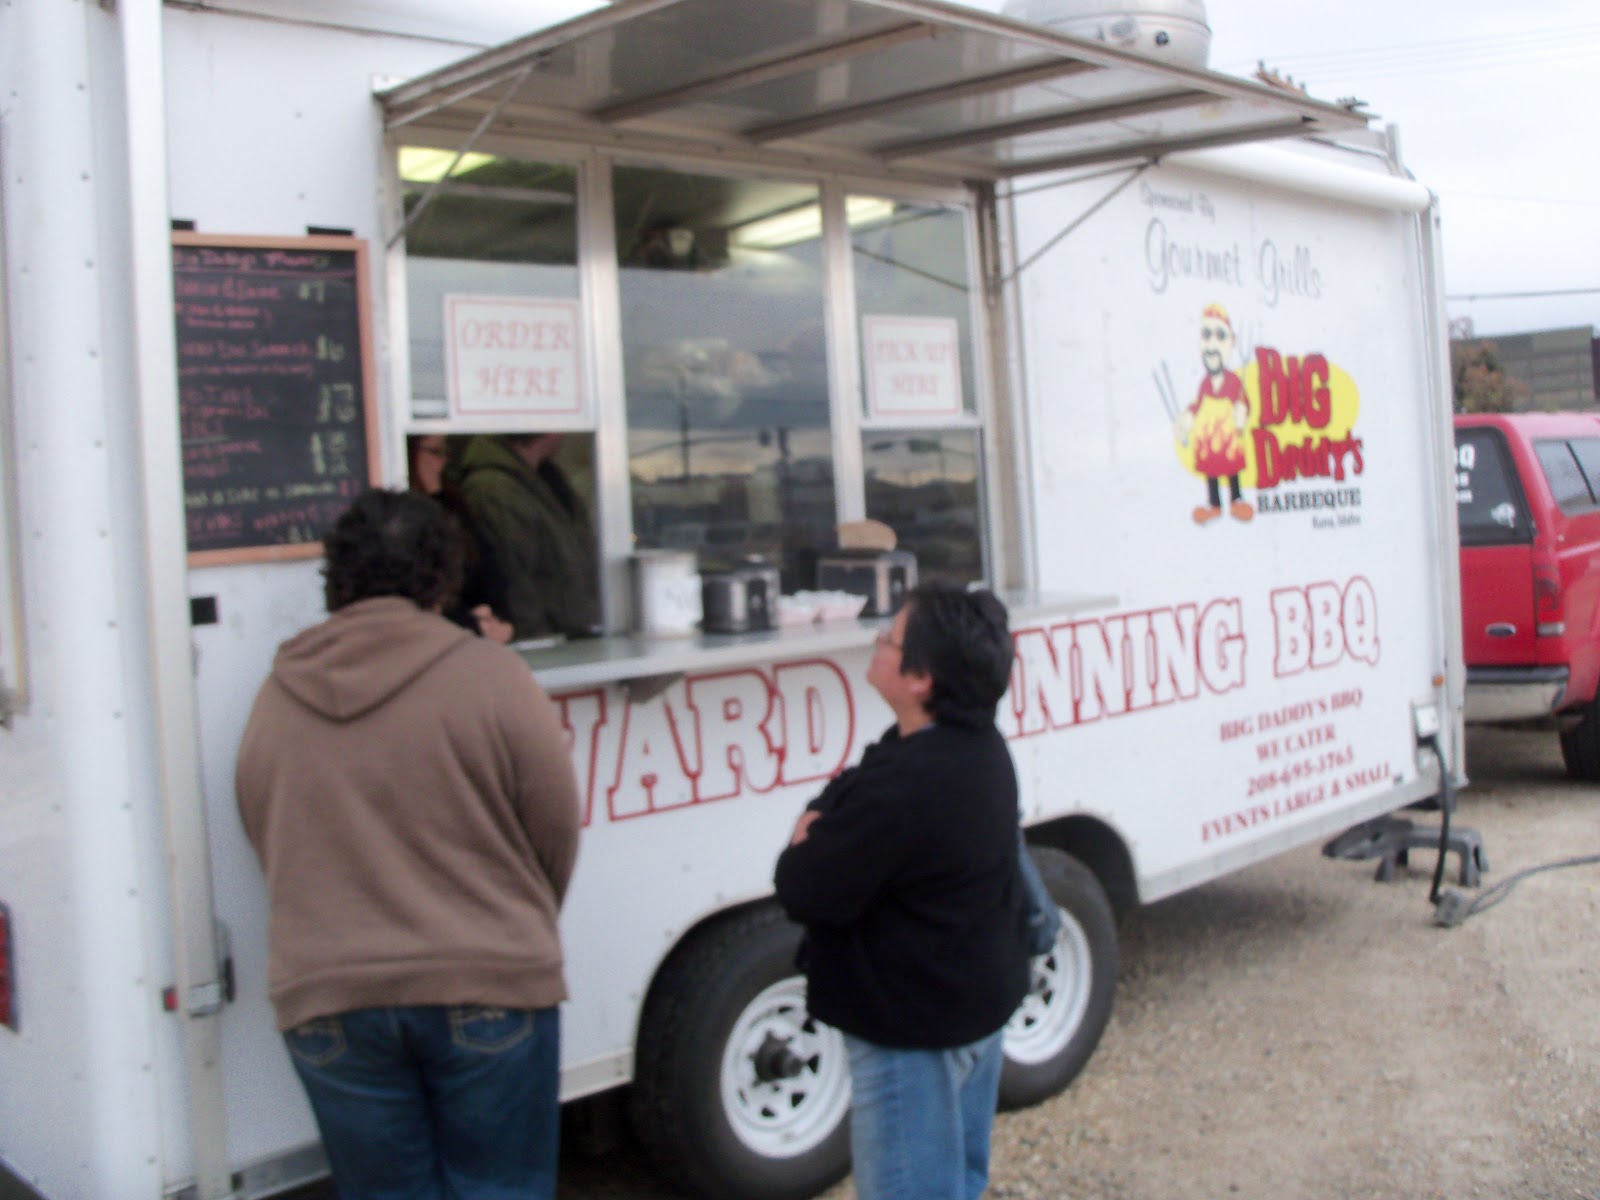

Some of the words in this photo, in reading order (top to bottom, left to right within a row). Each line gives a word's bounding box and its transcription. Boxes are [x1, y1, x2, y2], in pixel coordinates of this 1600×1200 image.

[461, 319, 571, 349] ORDER
[474, 364, 563, 396] HERE
[1255, 346, 1331, 429] BIG
[1257, 488, 1361, 513] BARBEQUE
[551, 657, 855, 827] ARD
[995, 597, 1246, 740] NNING
[1270, 575, 1380, 678] BBQ
[1220, 718, 1253, 742] BIG
[1257, 698, 1327, 734] DADDY'S
[1330, 688, 1364, 711] BBQ
[1256, 740, 1279, 761] WE
[1284, 723, 1337, 752] CATER
[1201, 804, 1271, 842] EVENTS
[1345, 762, 1392, 791] SMALL
